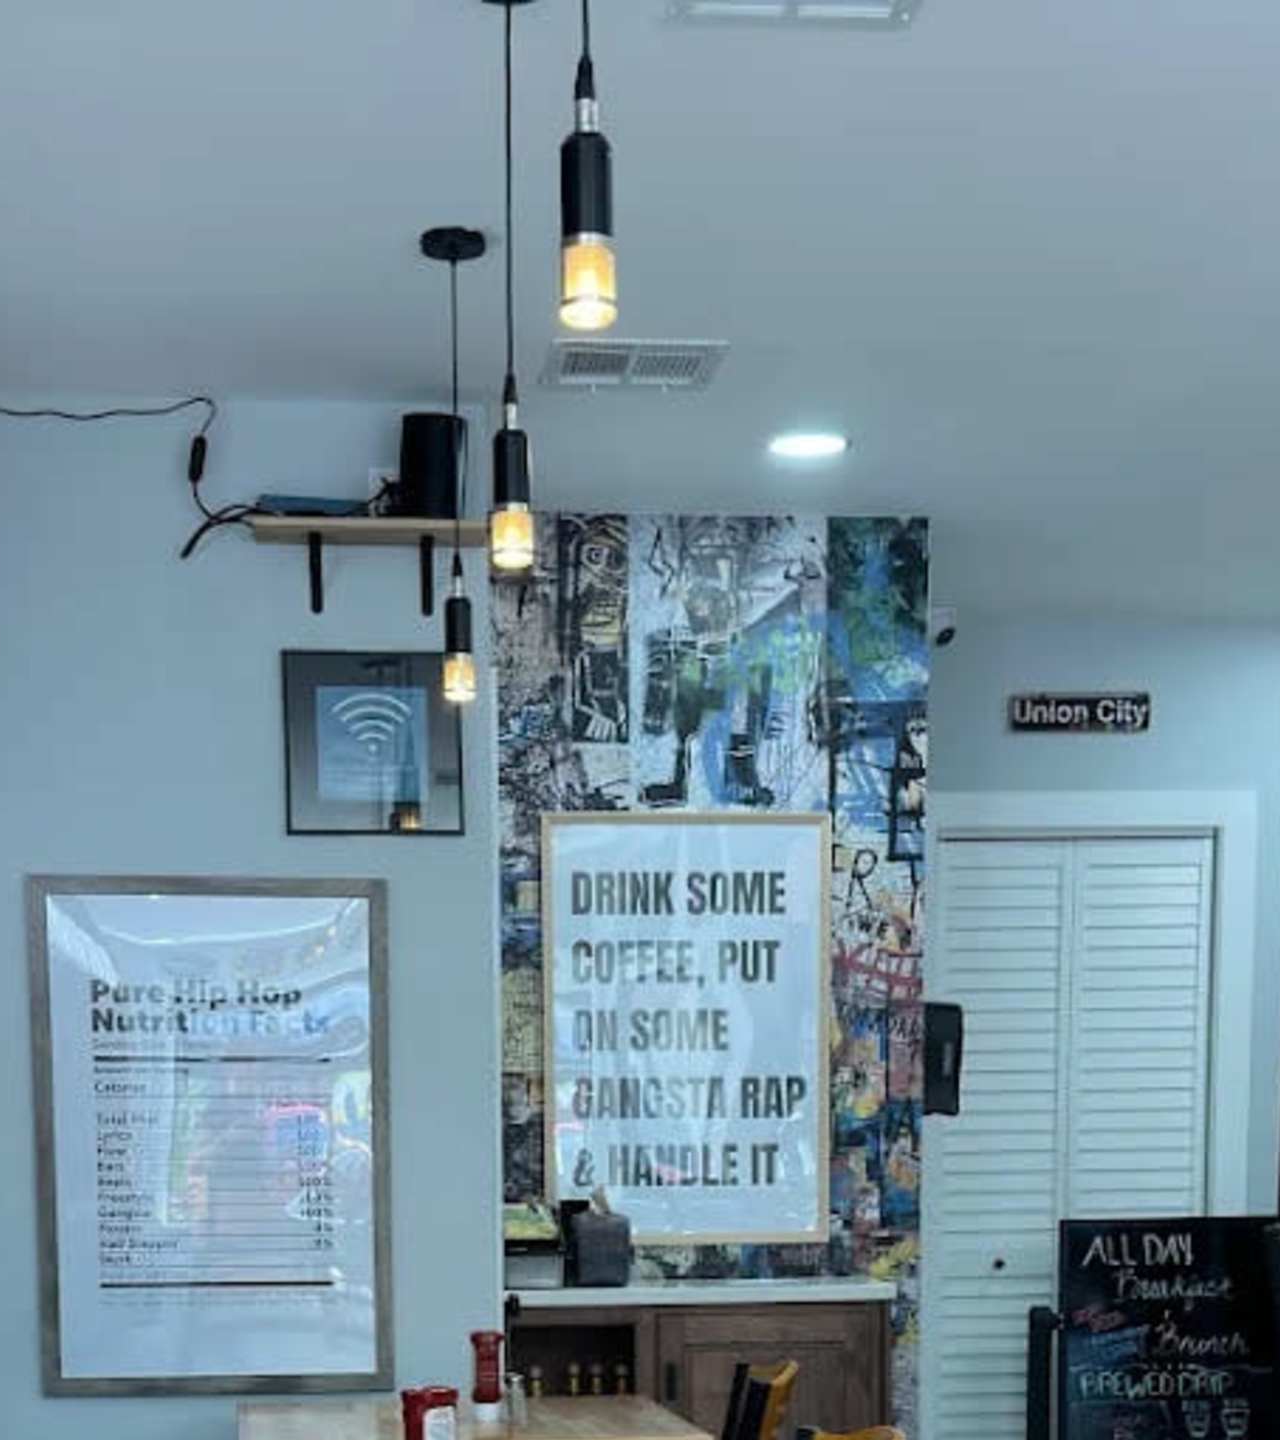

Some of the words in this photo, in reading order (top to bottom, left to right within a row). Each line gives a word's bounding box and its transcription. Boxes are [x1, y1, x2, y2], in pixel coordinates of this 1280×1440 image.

[1014, 700, 1089, 724] Union
[1096, 700, 1148, 728] City
[572, 871, 675, 916] DRINK
[687, 871, 786, 916] SOME
[572, 940, 706, 988] COFFEE,
[720, 941, 780, 982] PUT
[91, 979, 164, 1004] Pure
[174, 979, 227, 1010] Hip
[238, 979, 302, 1010] Hop
[91, 1008, 238, 1033] Nutrition
[249, 1009, 329, 1034] Facts
[574, 1010, 618, 1051] ON
[629, 1010, 730, 1051] SOME
[572, 1076, 728, 1119] GANGSTA
[740, 1076, 807, 1119] RAP
[573, 1148, 596, 1187] &
[608, 1143, 739, 1187] HANDLE
[751, 1143, 780, 1186] IT
[1082, 1234, 1137, 1267] ALL
[1142, 1232, 1194, 1267] DAY
[1080, 1369, 1174, 1398] BREWED
